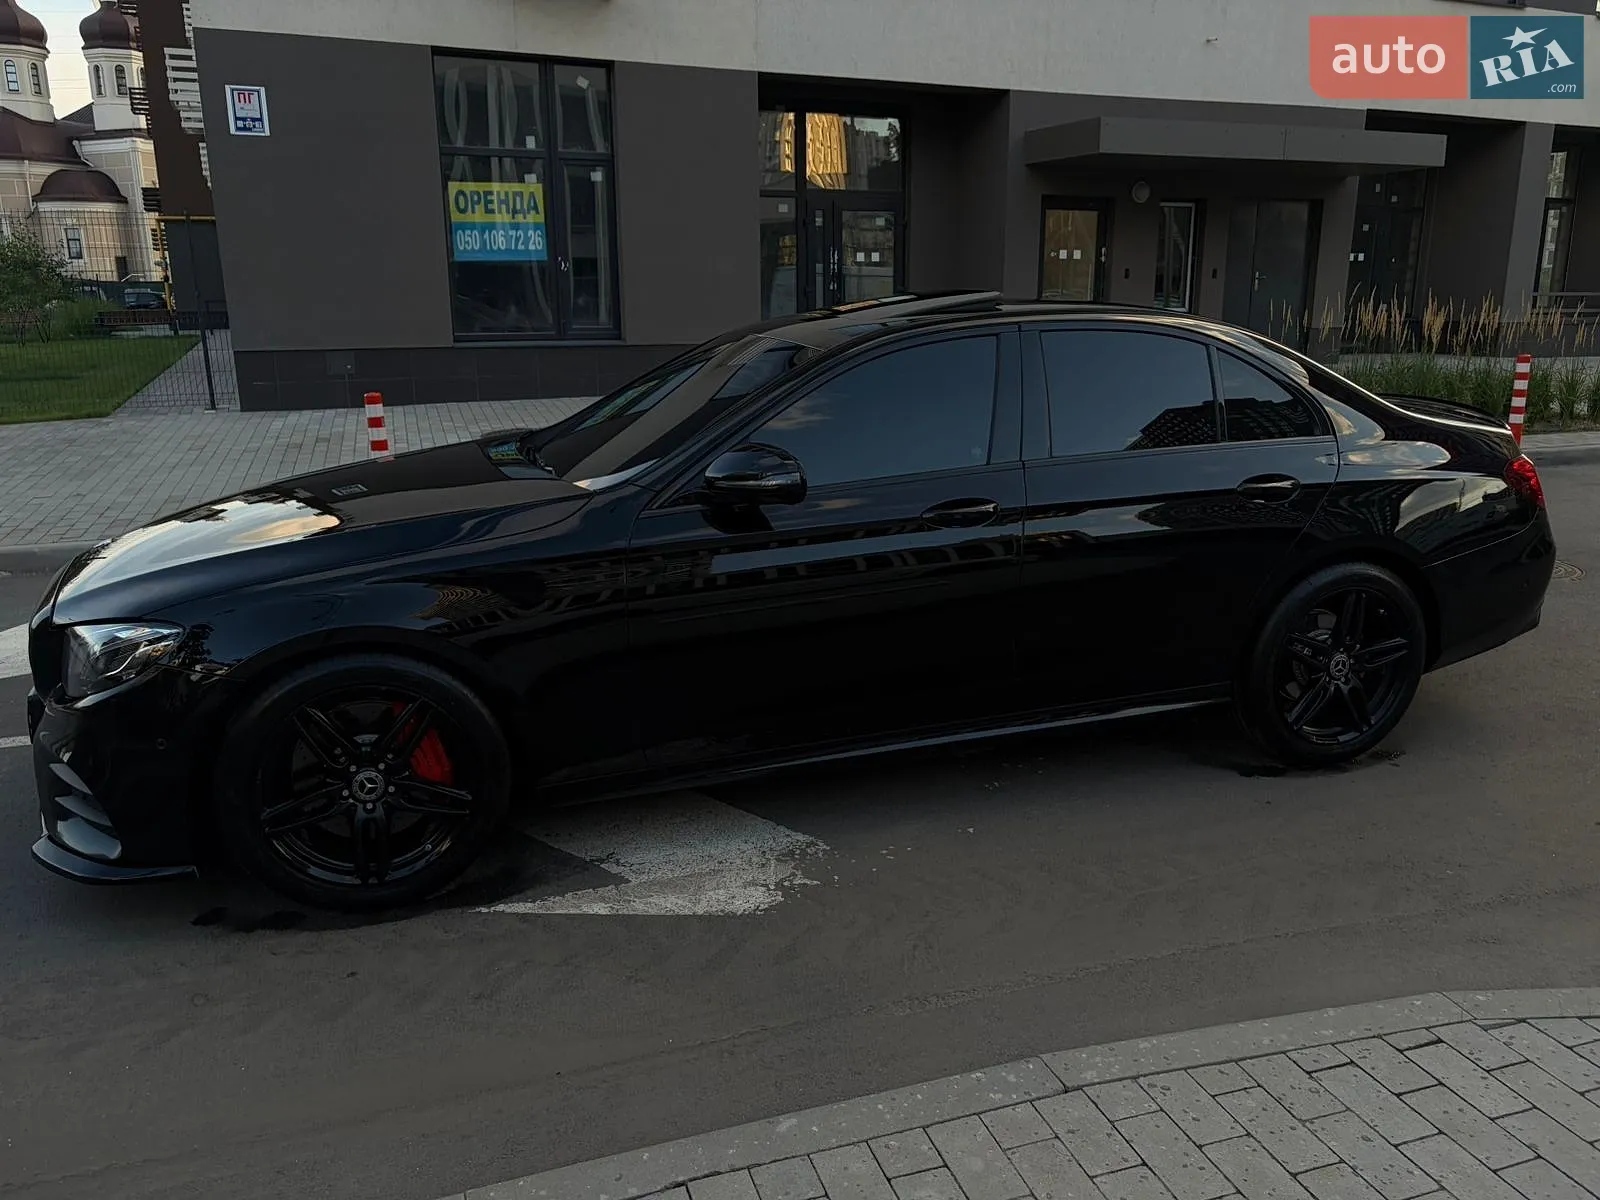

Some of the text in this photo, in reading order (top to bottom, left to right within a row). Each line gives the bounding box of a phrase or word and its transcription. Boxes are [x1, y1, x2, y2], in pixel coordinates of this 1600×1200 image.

[237, 92, 254, 104] ПГ
[454, 189, 540, 220] ОРЕНДА
[456, 229, 543, 250] 050 106 72 26
